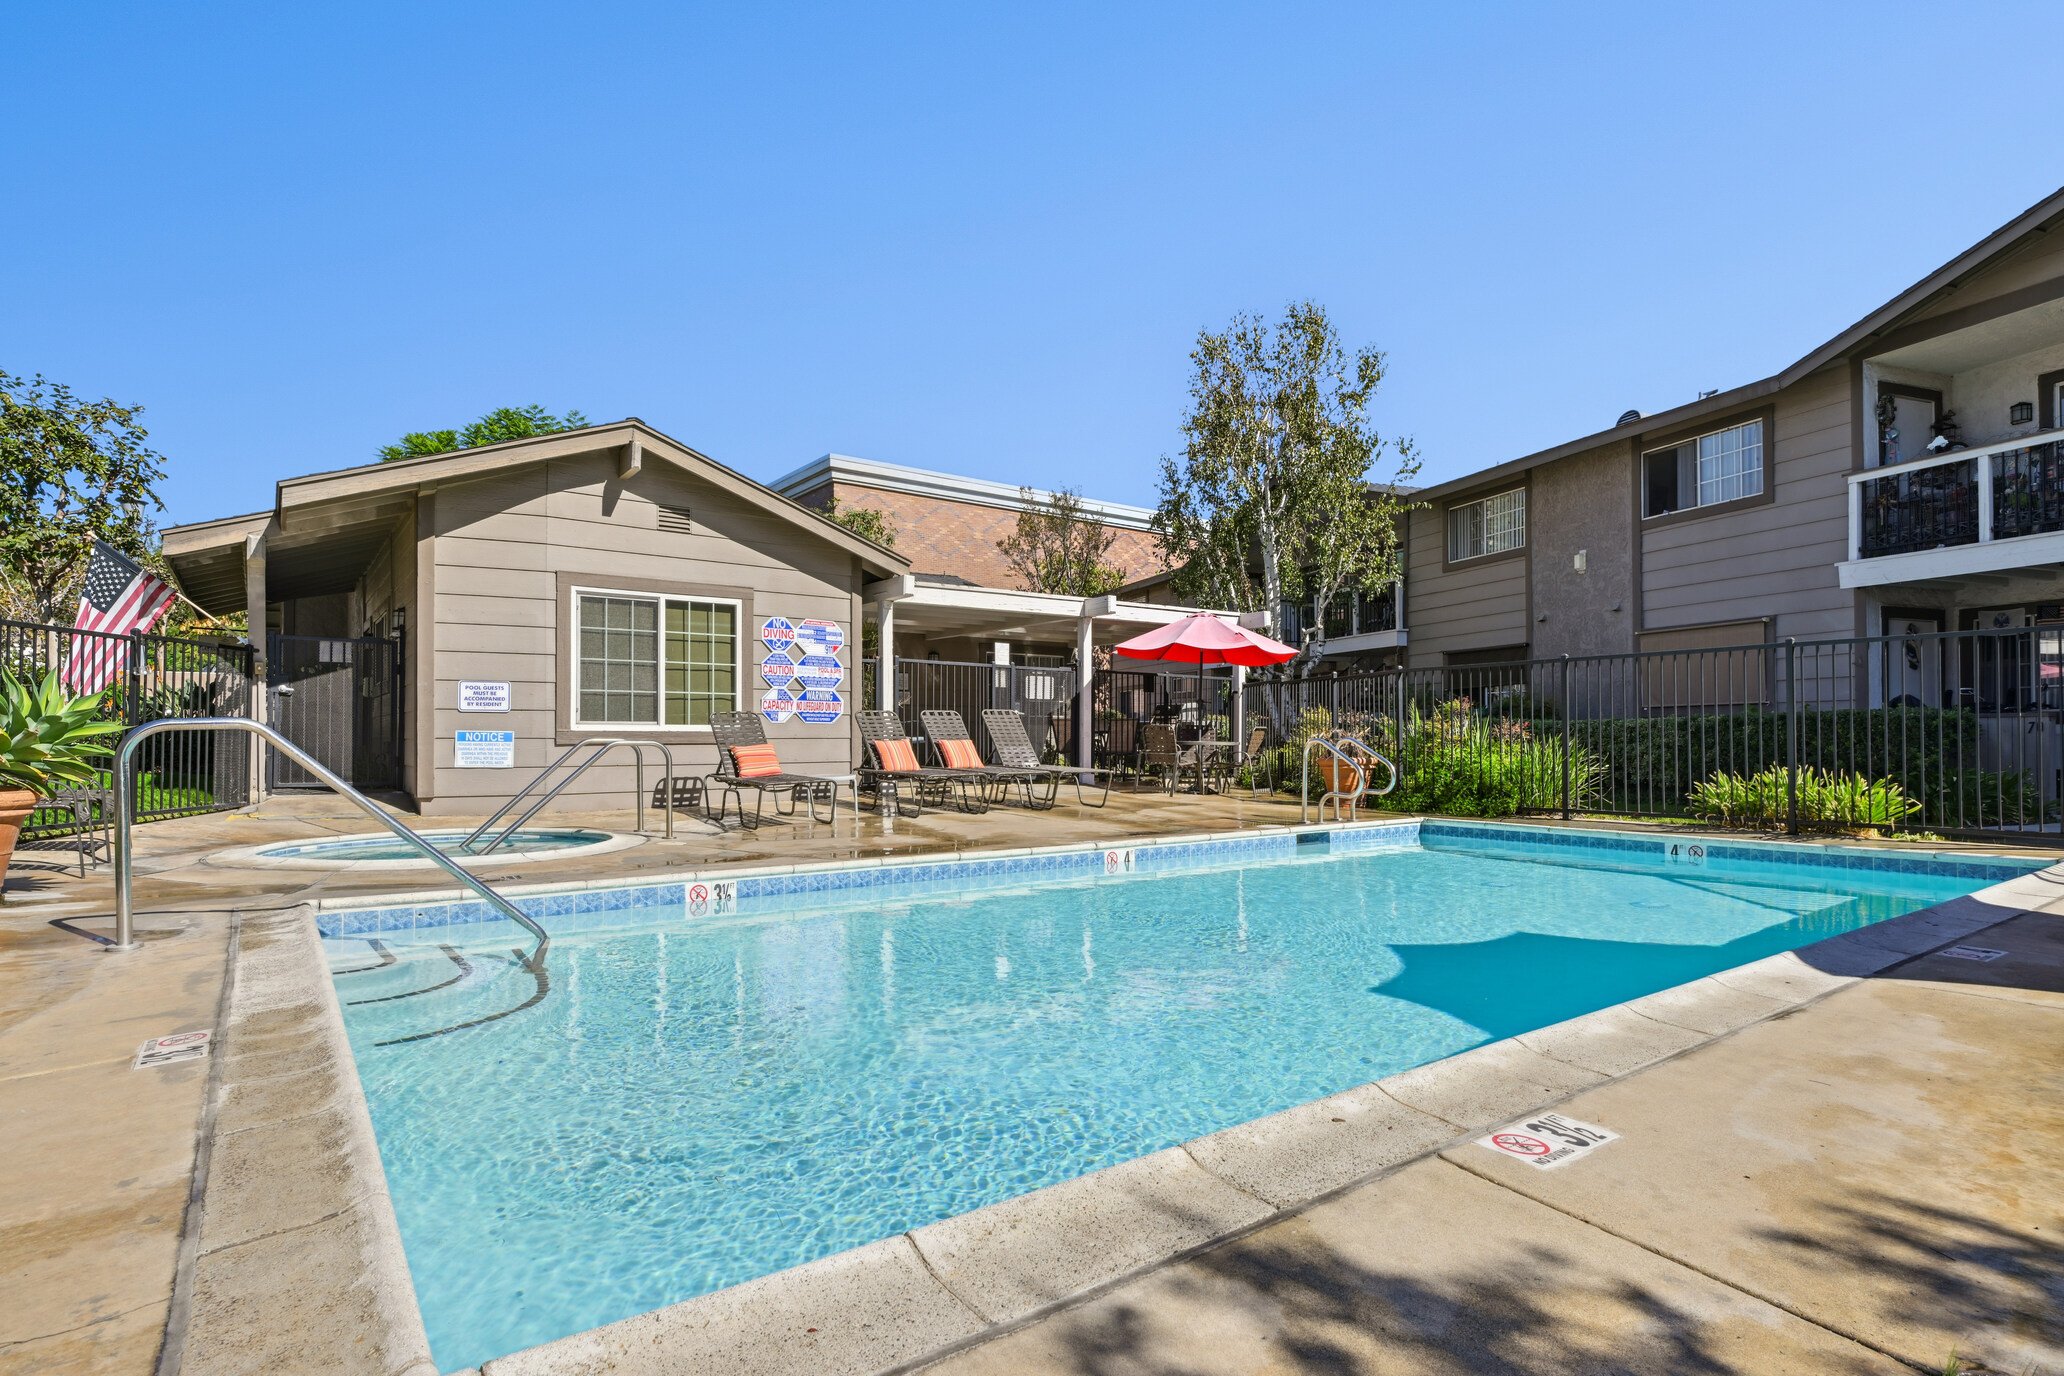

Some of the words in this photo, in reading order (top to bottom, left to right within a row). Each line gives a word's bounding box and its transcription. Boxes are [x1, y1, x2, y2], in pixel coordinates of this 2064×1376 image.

[773, 619, 786, 628] NO
[763, 628, 795, 639] DIVING
[763, 665, 794, 674] CAUTION
[806, 691, 834, 701] WARNING
[763, 701, 794, 709] CAPACITY
[797, 701, 802, 710] NO
[803, 702, 824, 710] LIFEGUARD
[825, 702, 831, 711] ON
[832, 703, 841, 711] DUTY
[465, 733, 504, 741] NOTICE
[1671, 844, 1679, 855] 4
[1124, 851, 1130, 862] 4
[1532, 1157, 1551, 1165] NO
[1544, 1147, 1575, 1160] DIVING
